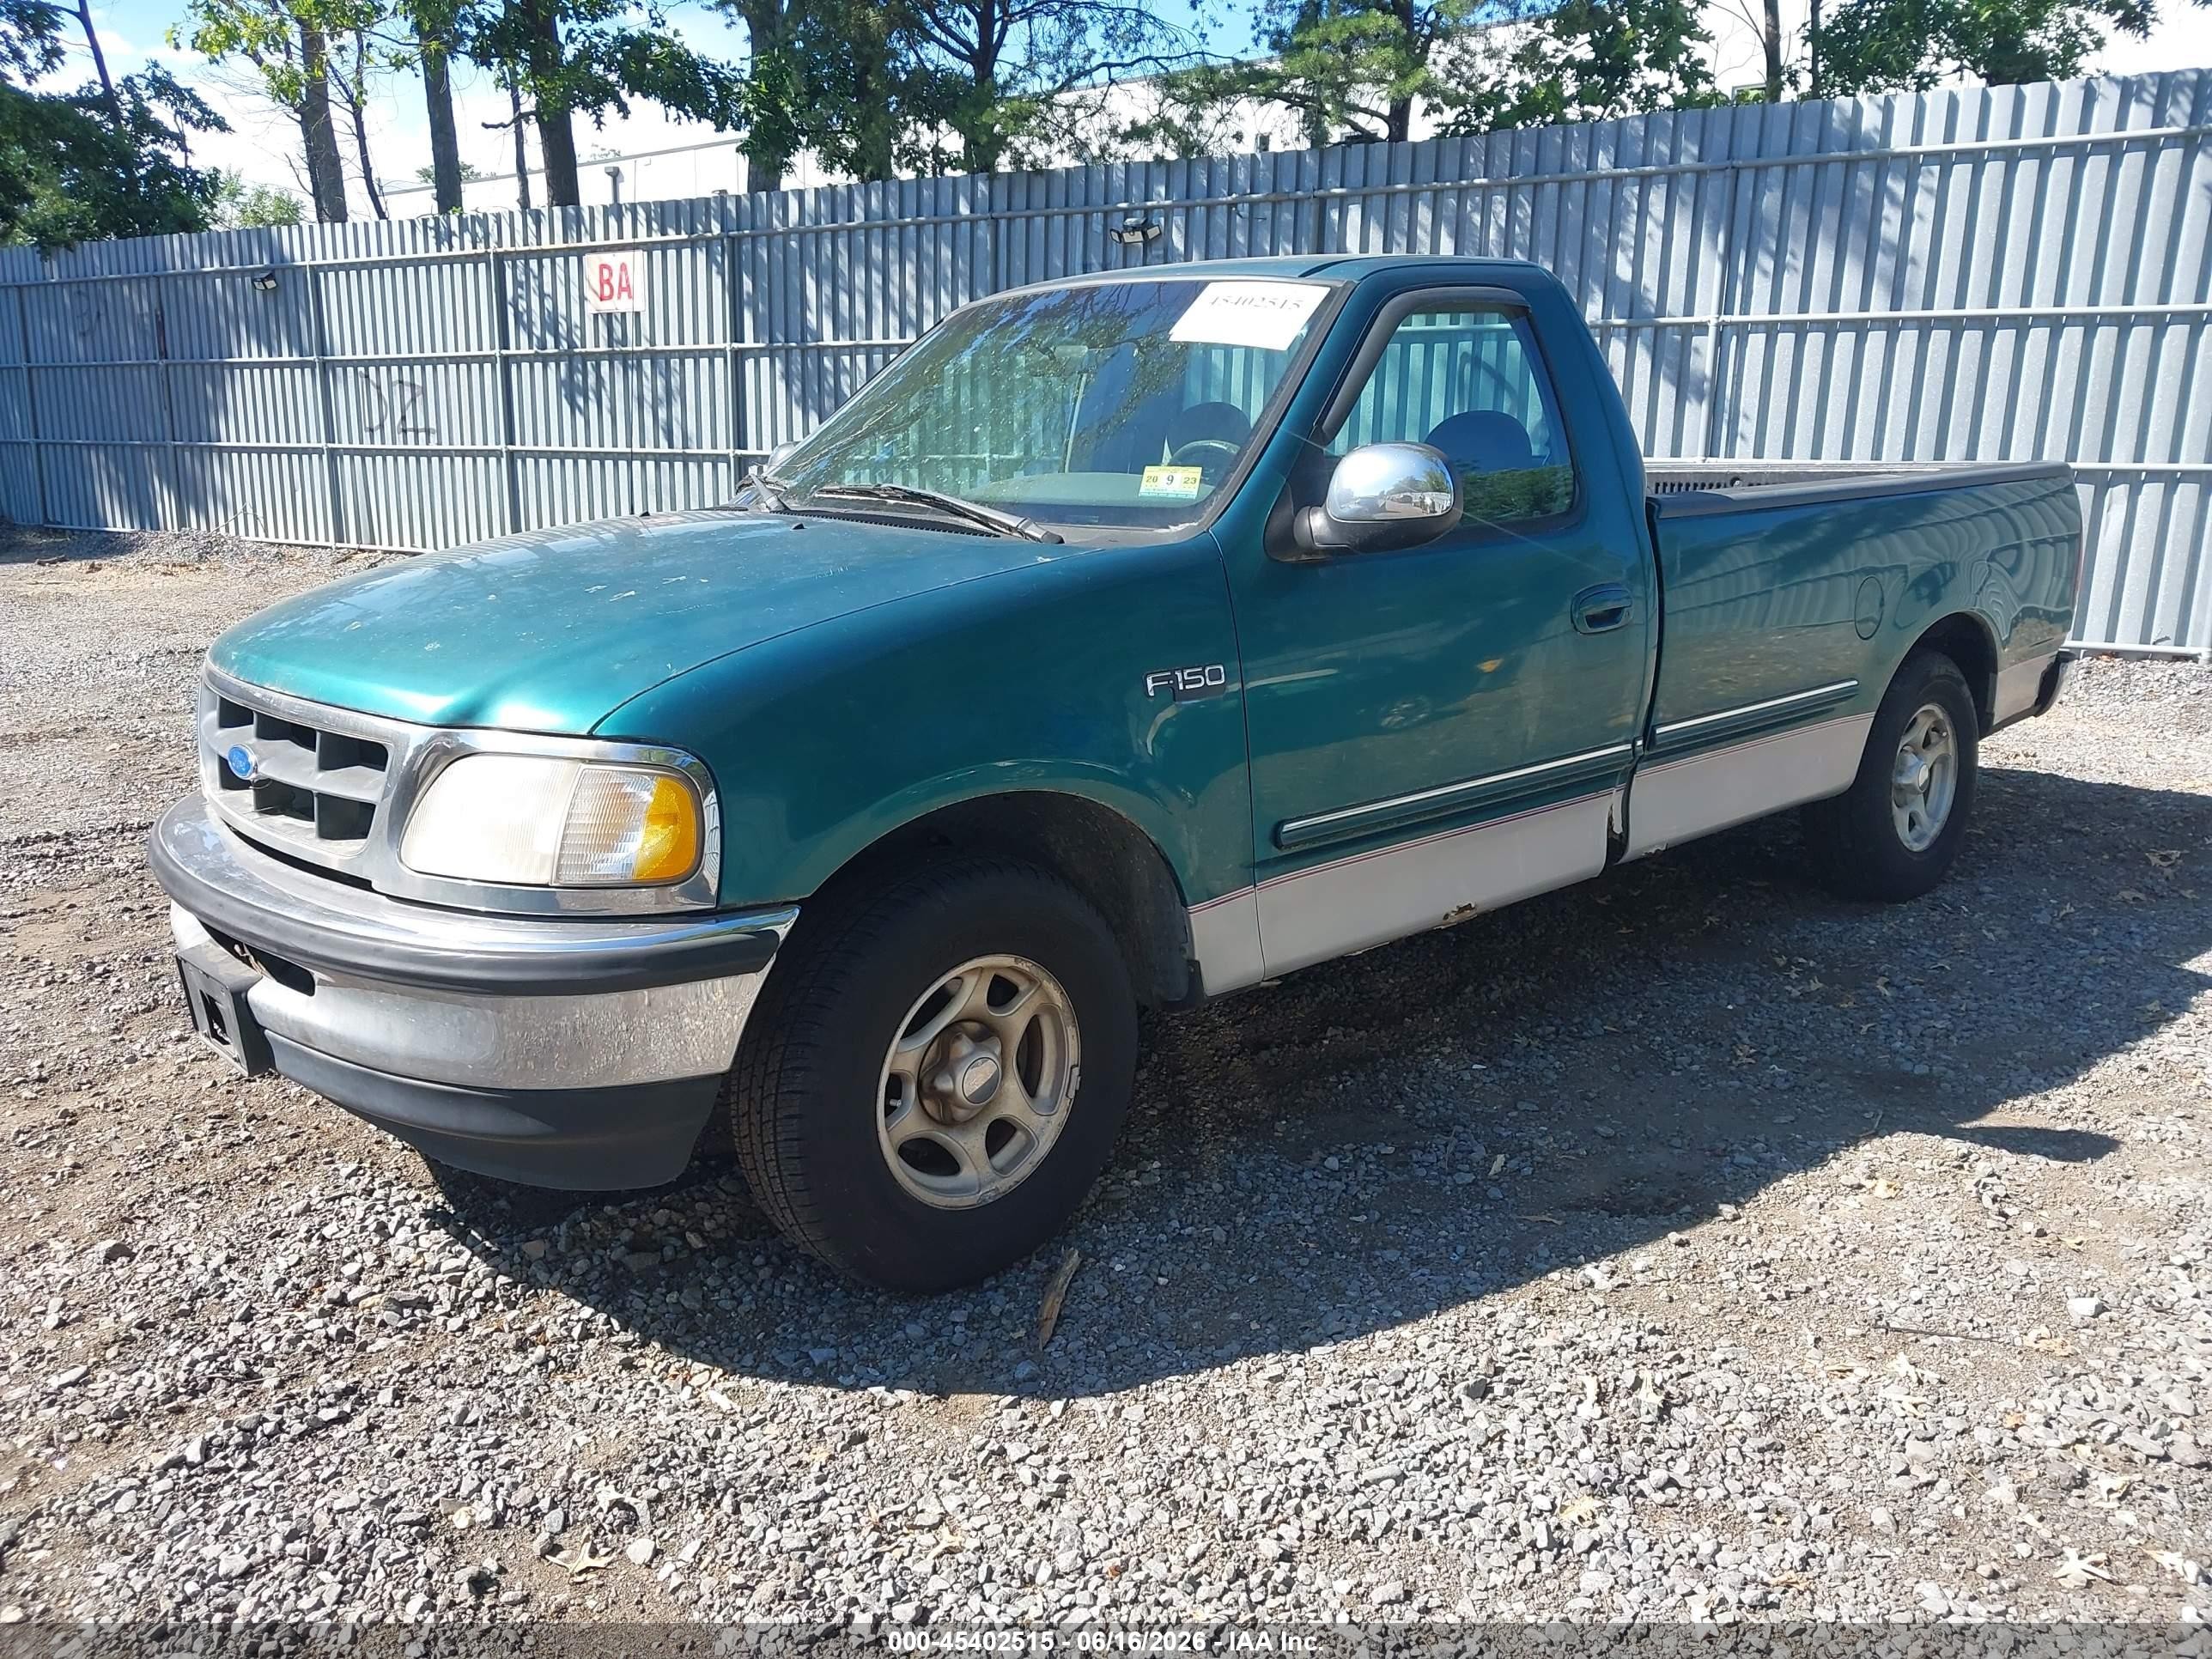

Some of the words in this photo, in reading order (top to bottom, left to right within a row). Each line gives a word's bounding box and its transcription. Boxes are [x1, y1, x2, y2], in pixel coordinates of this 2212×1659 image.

[599, 262, 633, 302] BA
[1146, 475, 1158, 483] 20
[1165, 474, 1175, 486] 9
[1182, 477, 1197, 485] 23
